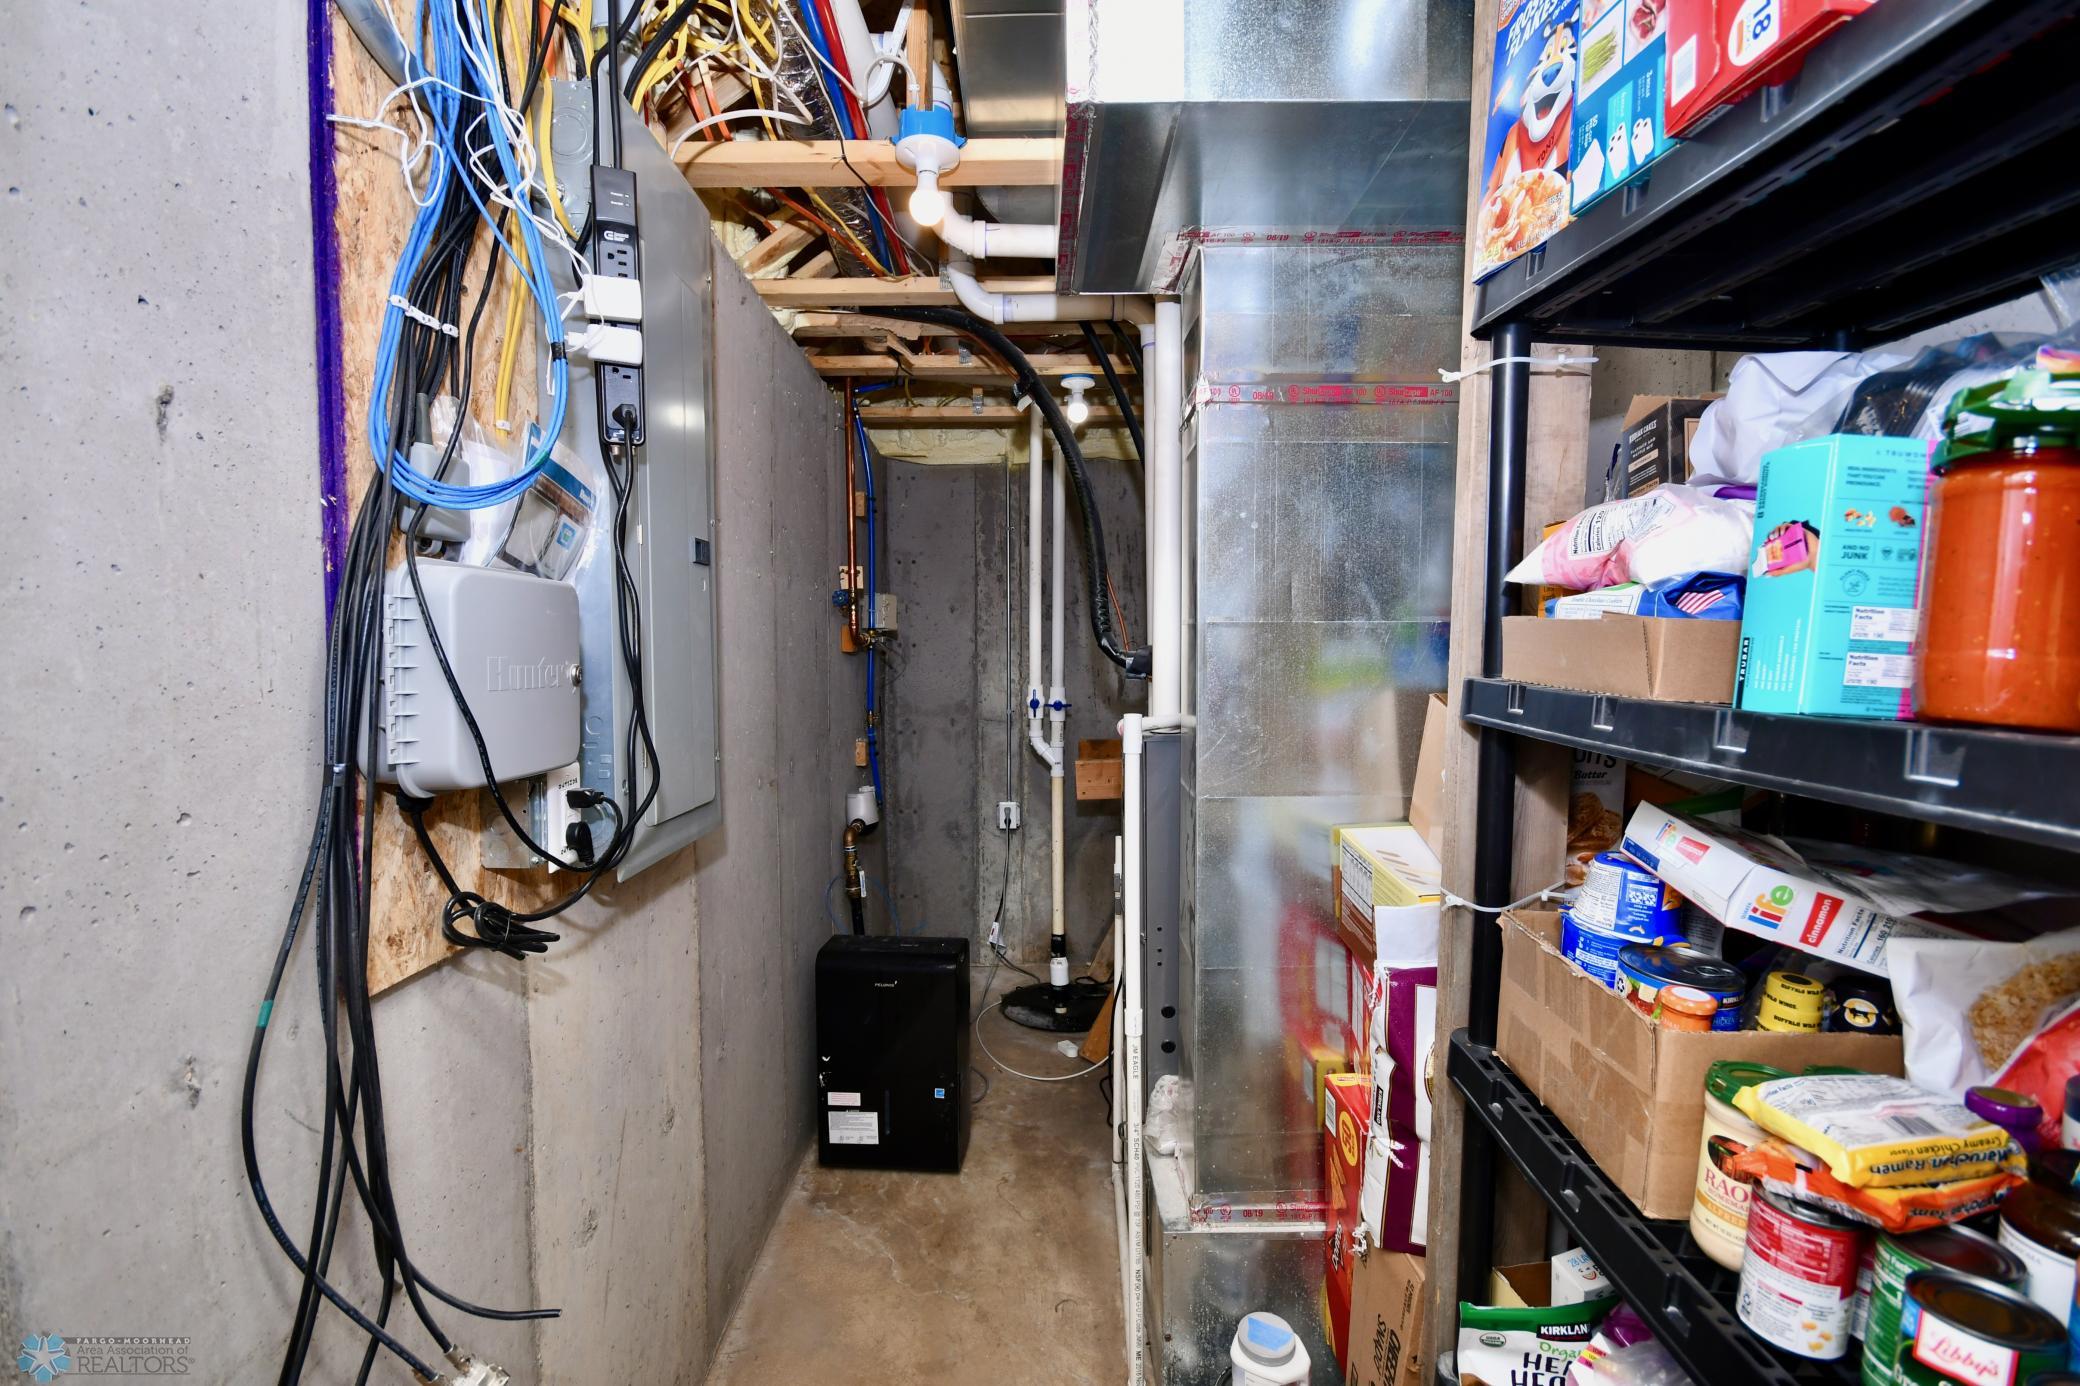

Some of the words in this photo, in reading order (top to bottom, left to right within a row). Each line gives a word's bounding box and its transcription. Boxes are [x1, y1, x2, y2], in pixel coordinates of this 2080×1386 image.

[1643, 420, 1657, 434] CAKES
[1842, 543, 1858, 551] AND
[1859, 544, 1870, 552] NO
[1841, 551, 1869, 561] JUNK
[1855, 607, 1885, 615] Nutrition
[1855, 613, 1873, 621] Facts
[1739, 639, 1750, 682] TRUBAR
[1848, 660, 1867, 668] Facts
[1849, 654, 1879, 662] Nutrition
[1575, 770, 1609, 780] Butter
[1747, 884, 1795, 930] life
[1807, 898, 1833, 945] cinnamon
[1837, 925, 1856, 955] Nutrition
[1853, 908, 1865, 927] Facts
[1877, 930, 1889, 942] 160
[1780, 983, 1806, 995] BUFFALO
[1773, 1014, 1801, 1027] BUFFALO
[1963, 1136, 2002, 1148] Creamy
[1916, 1142, 1961, 1155] Chicken
[1869, 1159, 1926, 1175] Ramen
[1568, 1257, 1580, 1268] 28
[1930, 1335, 2000, 1377] Libby's
